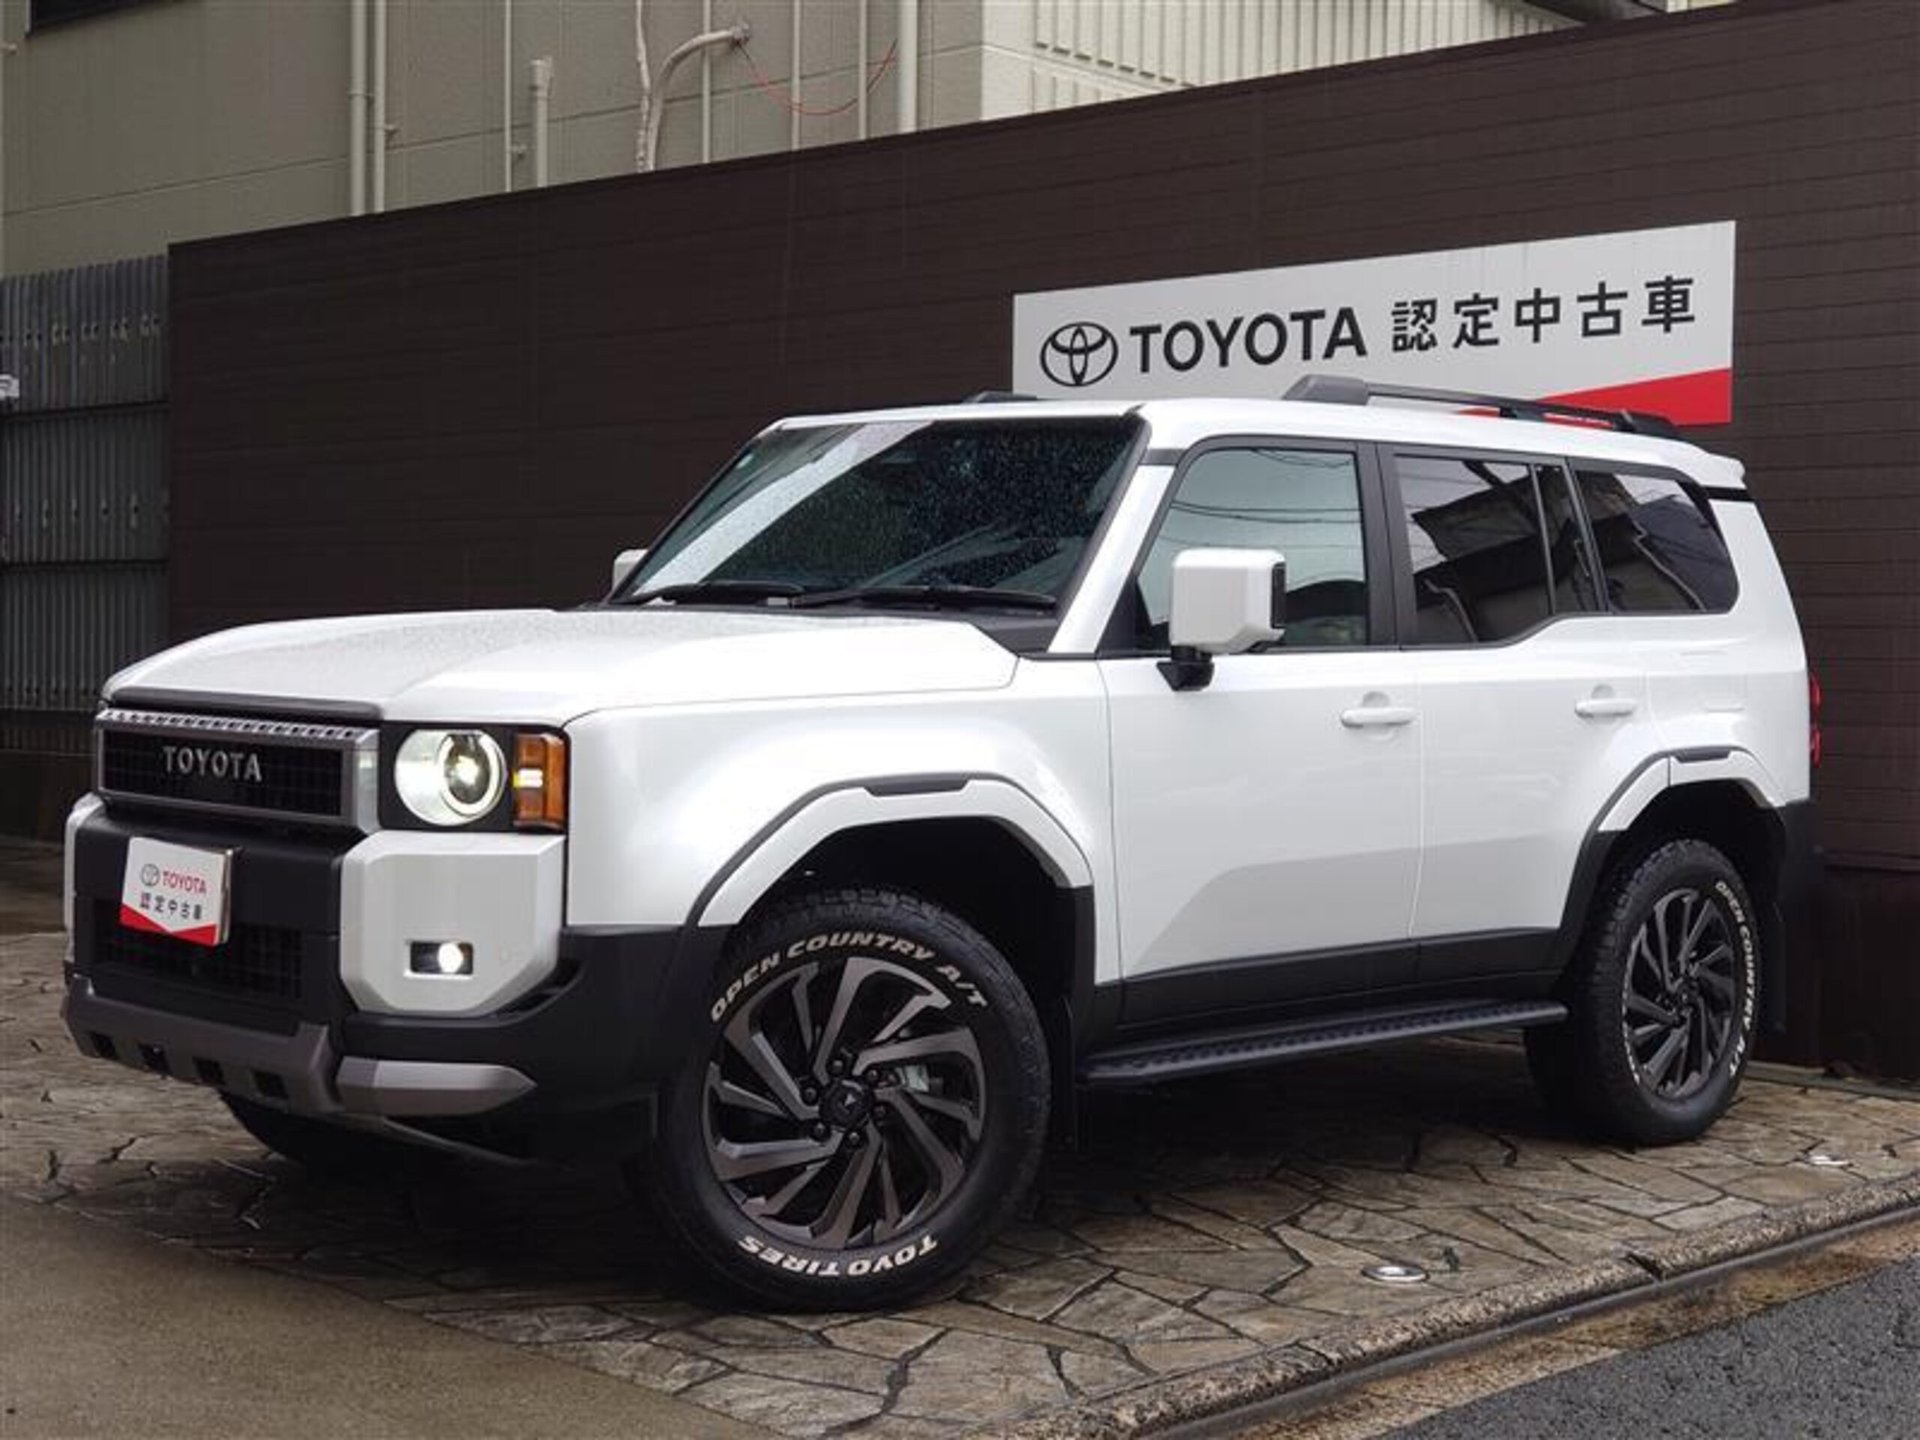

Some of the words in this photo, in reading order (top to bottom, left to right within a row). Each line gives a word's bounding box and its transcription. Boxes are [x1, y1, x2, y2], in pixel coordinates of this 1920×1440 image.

[1129, 306, 1368, 373] TOYOTA
[1390, 275, 1697, 354] 認定中古車
[162, 745, 262, 782] TOYOTA
[162, 869, 207, 895] TOYOTA
[710, 952, 781, 1022] OPEN
[786, 931, 936, 961] COUNTRY
[935, 963, 988, 1008] A/T
[737, 1234, 841, 1277] TIRES
[846, 1234, 938, 1277] TOYO
